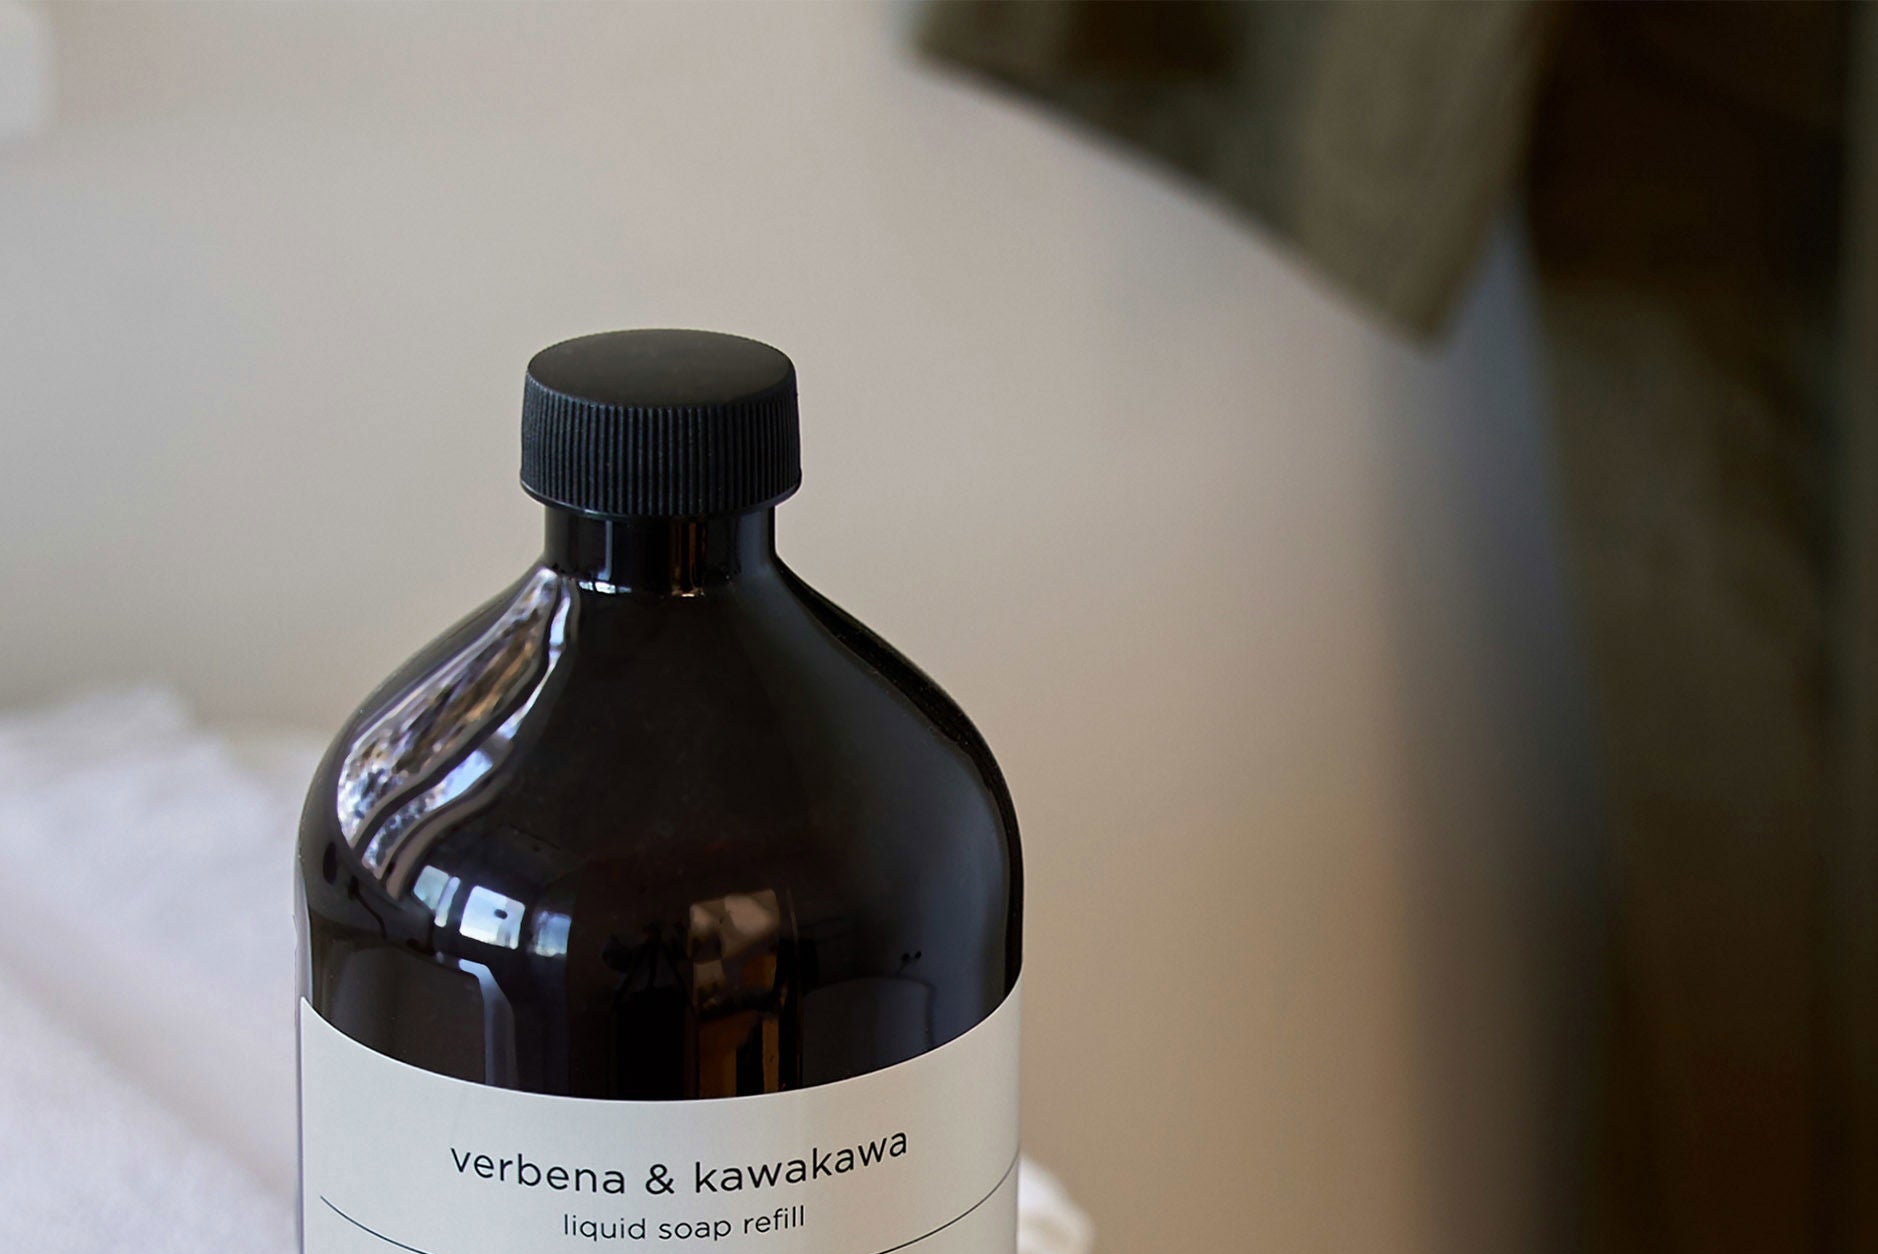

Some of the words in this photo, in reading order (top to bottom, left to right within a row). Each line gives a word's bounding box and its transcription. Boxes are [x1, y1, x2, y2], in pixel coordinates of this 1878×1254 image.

[450, 1147, 625, 1195] verbena
[644, 1163, 675, 1196] &
[695, 1132, 907, 1194] kawakawa
[564, 1213, 646, 1243] liquid
[658, 1219, 732, 1242] soap
[743, 1204, 804, 1235] refill
